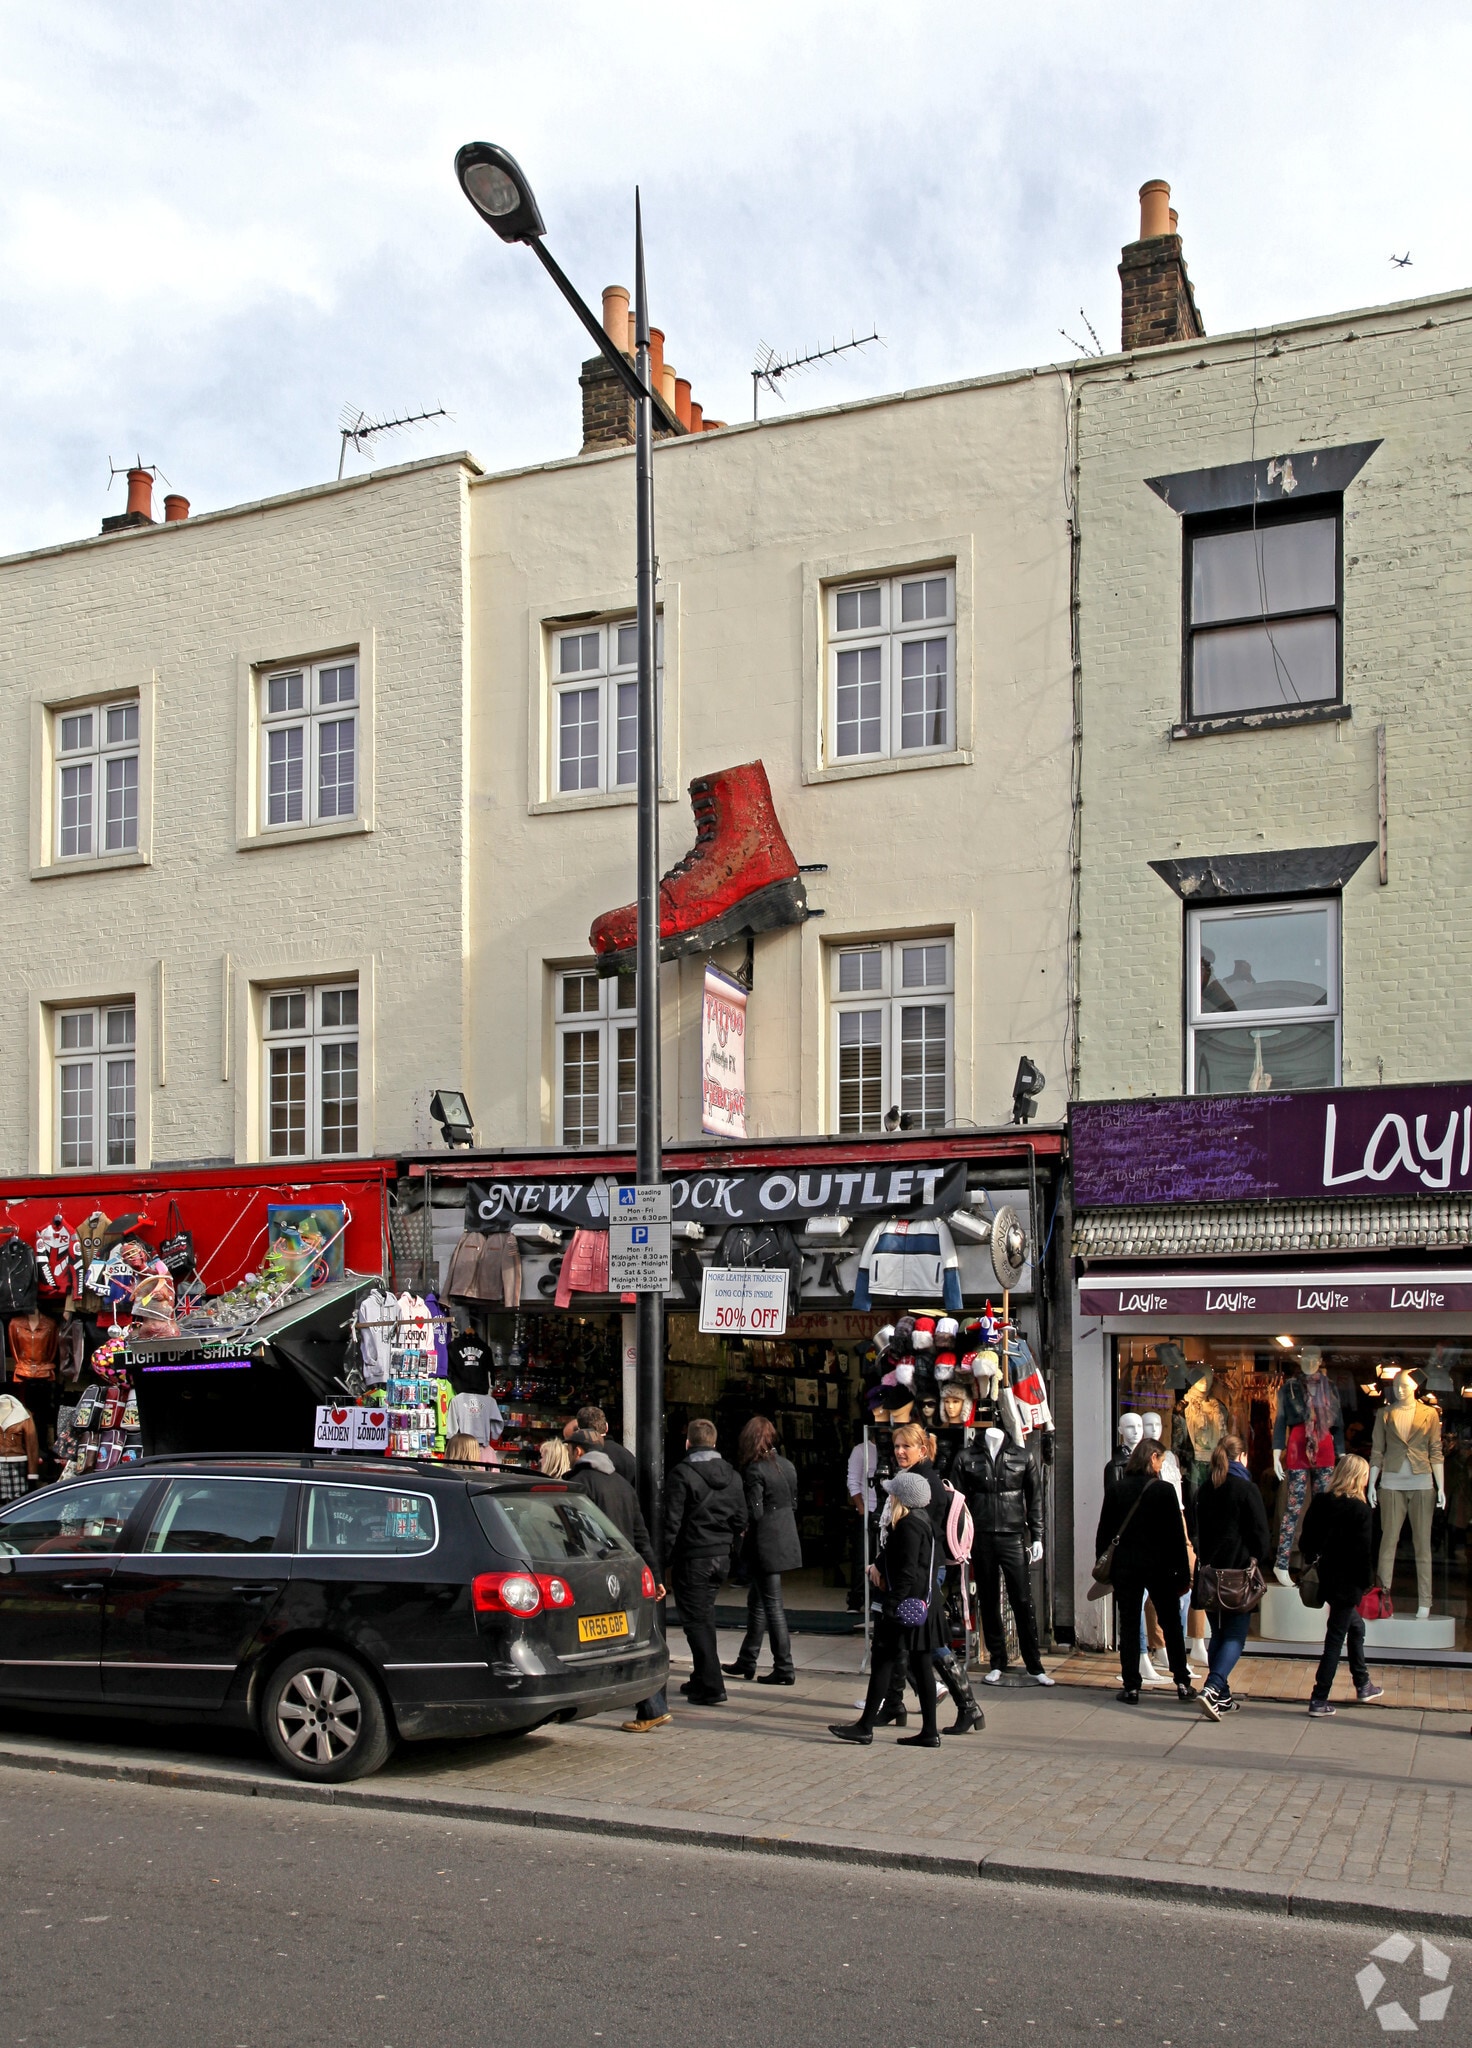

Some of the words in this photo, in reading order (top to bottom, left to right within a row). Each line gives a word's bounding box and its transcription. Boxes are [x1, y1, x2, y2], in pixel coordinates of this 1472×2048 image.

[706, 994, 743, 1047] TATTOO
[478, 1184, 582, 1220] NEW
[671, 1178, 744, 1216] OCK
[759, 1168, 944, 1211] OUTLET
[635, 1228, 646, 1242] P
[726, 1274, 751, 1282] LEATHER
[1118, 1292, 1168, 1312] Laylie
[1206, 1290, 1256, 1311] Laylie
[1297, 1289, 1349, 1310] Laylie
[1390, 1288, 1445, 1309] Laylie
[715, 1307, 746, 1327] 50%
[751, 1308, 779, 1328] OFF
[125, 1351, 161, 1364] LIGHT
[168, 1350, 185, 1362] UP
[322, 1409, 329, 1424] I
[361, 1412, 368, 1425] I
[317, 1425, 350, 1442] CAMDEN
[357, 1427, 386, 1440] LONDON
[582, 1617, 608, 1637] YR56
[608, 1615, 623, 1633] GBF
